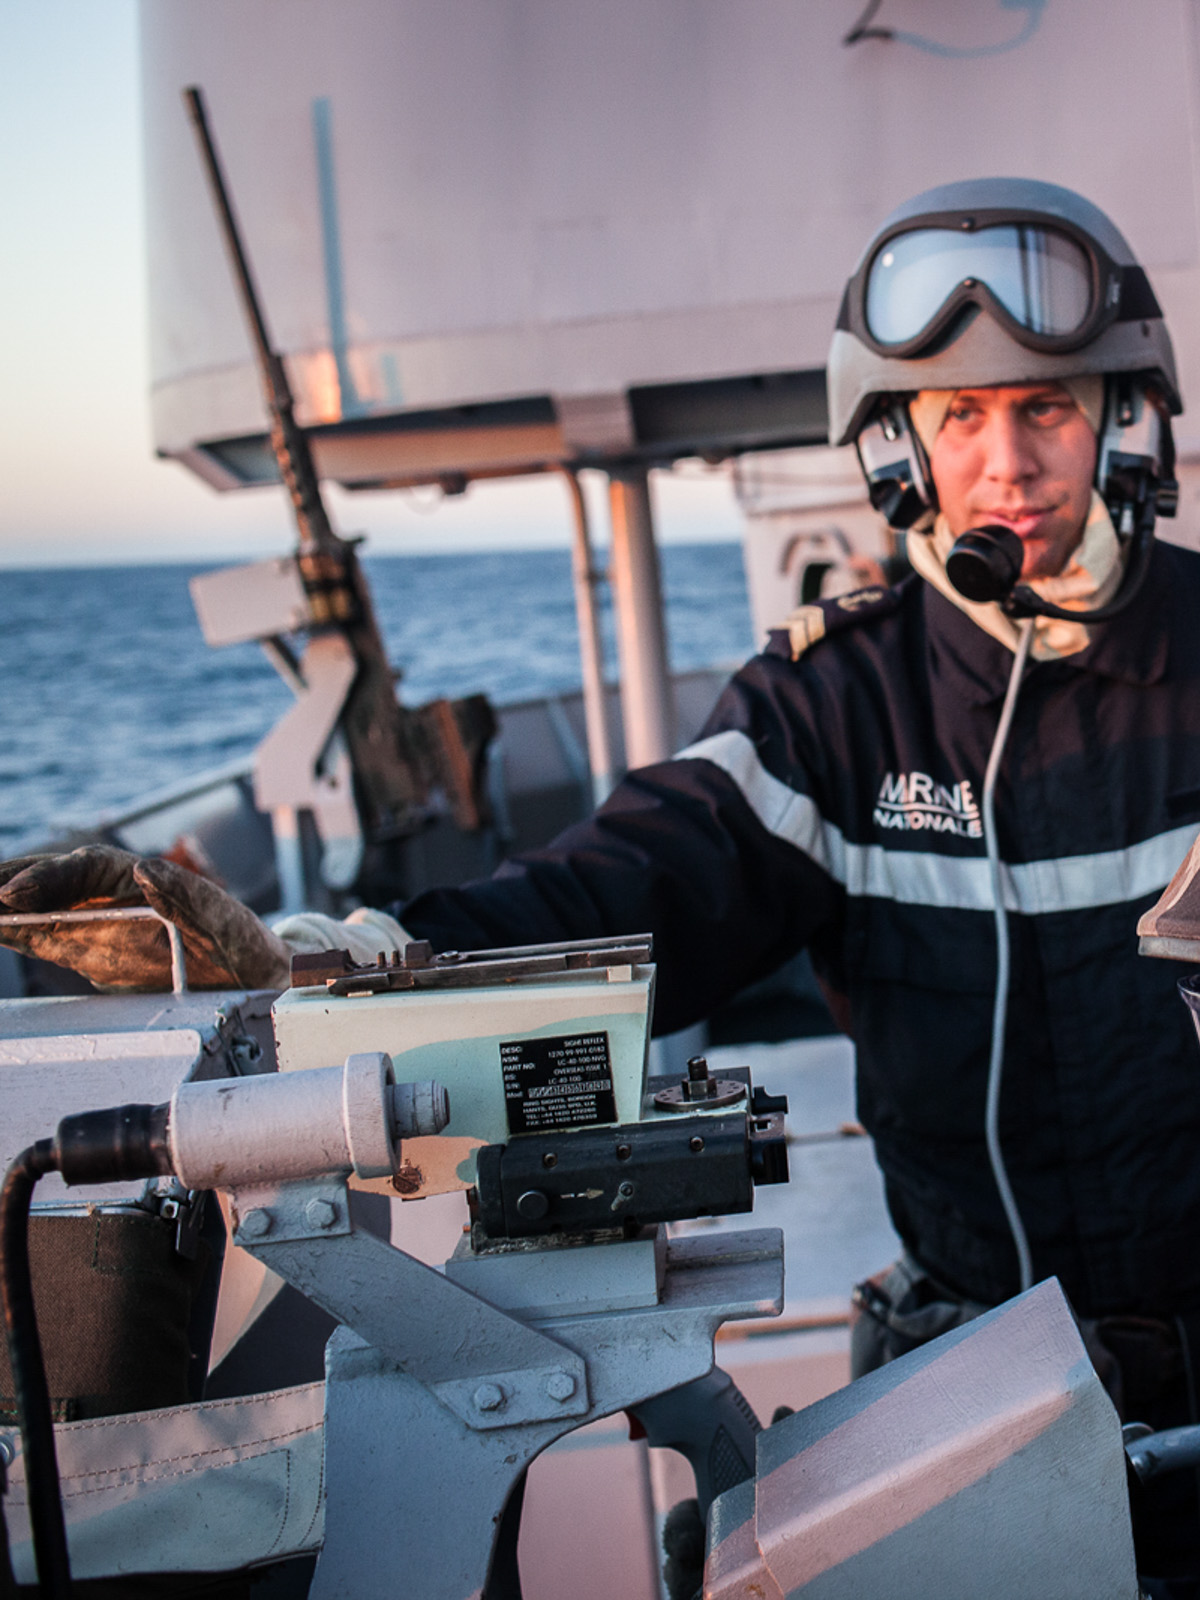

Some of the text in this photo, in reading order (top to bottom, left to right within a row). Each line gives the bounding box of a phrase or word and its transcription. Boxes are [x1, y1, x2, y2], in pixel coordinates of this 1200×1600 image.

[583, 1037, 605, 1045] REFLEX
[504, 1064, 522, 1072] PART
[554, 1066, 585, 1076] OVERSEAS
